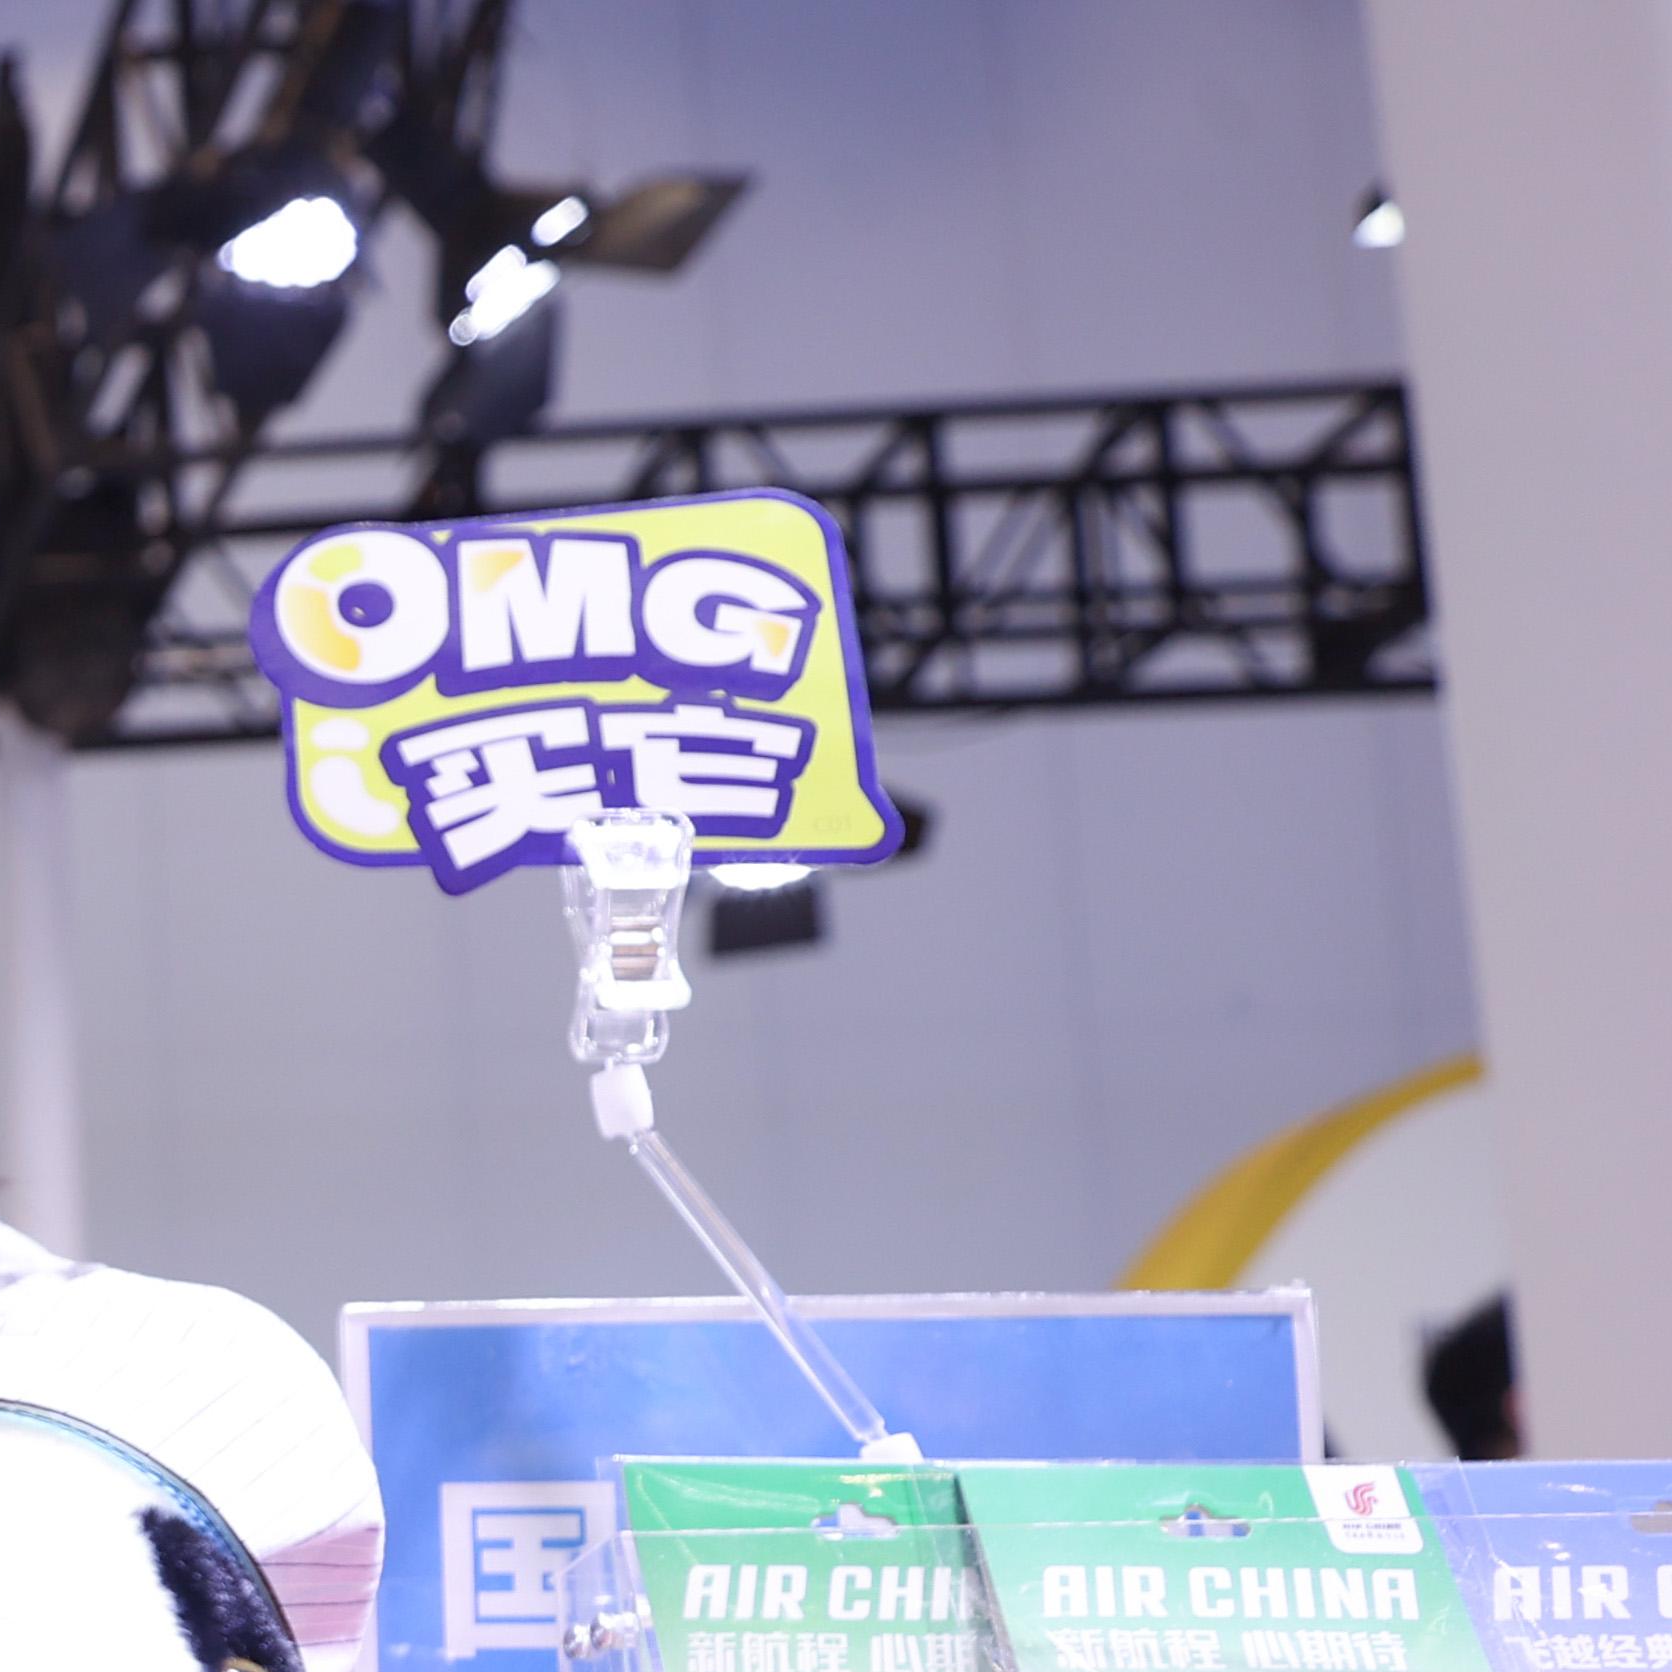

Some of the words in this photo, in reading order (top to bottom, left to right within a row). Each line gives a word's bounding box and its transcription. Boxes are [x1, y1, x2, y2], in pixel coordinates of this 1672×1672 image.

[275, 528, 808, 684] OMG
[683, 1564, 808, 1620] AIR
[1043, 1564, 1168, 1618] AIR
[1188, 1566, 1420, 1620] CHINA
[1493, 1564, 1632, 1620] AIR
[1048, 1629, 1226, 1671] 新航程
[1242, 1629, 1409, 1672] 心期待
